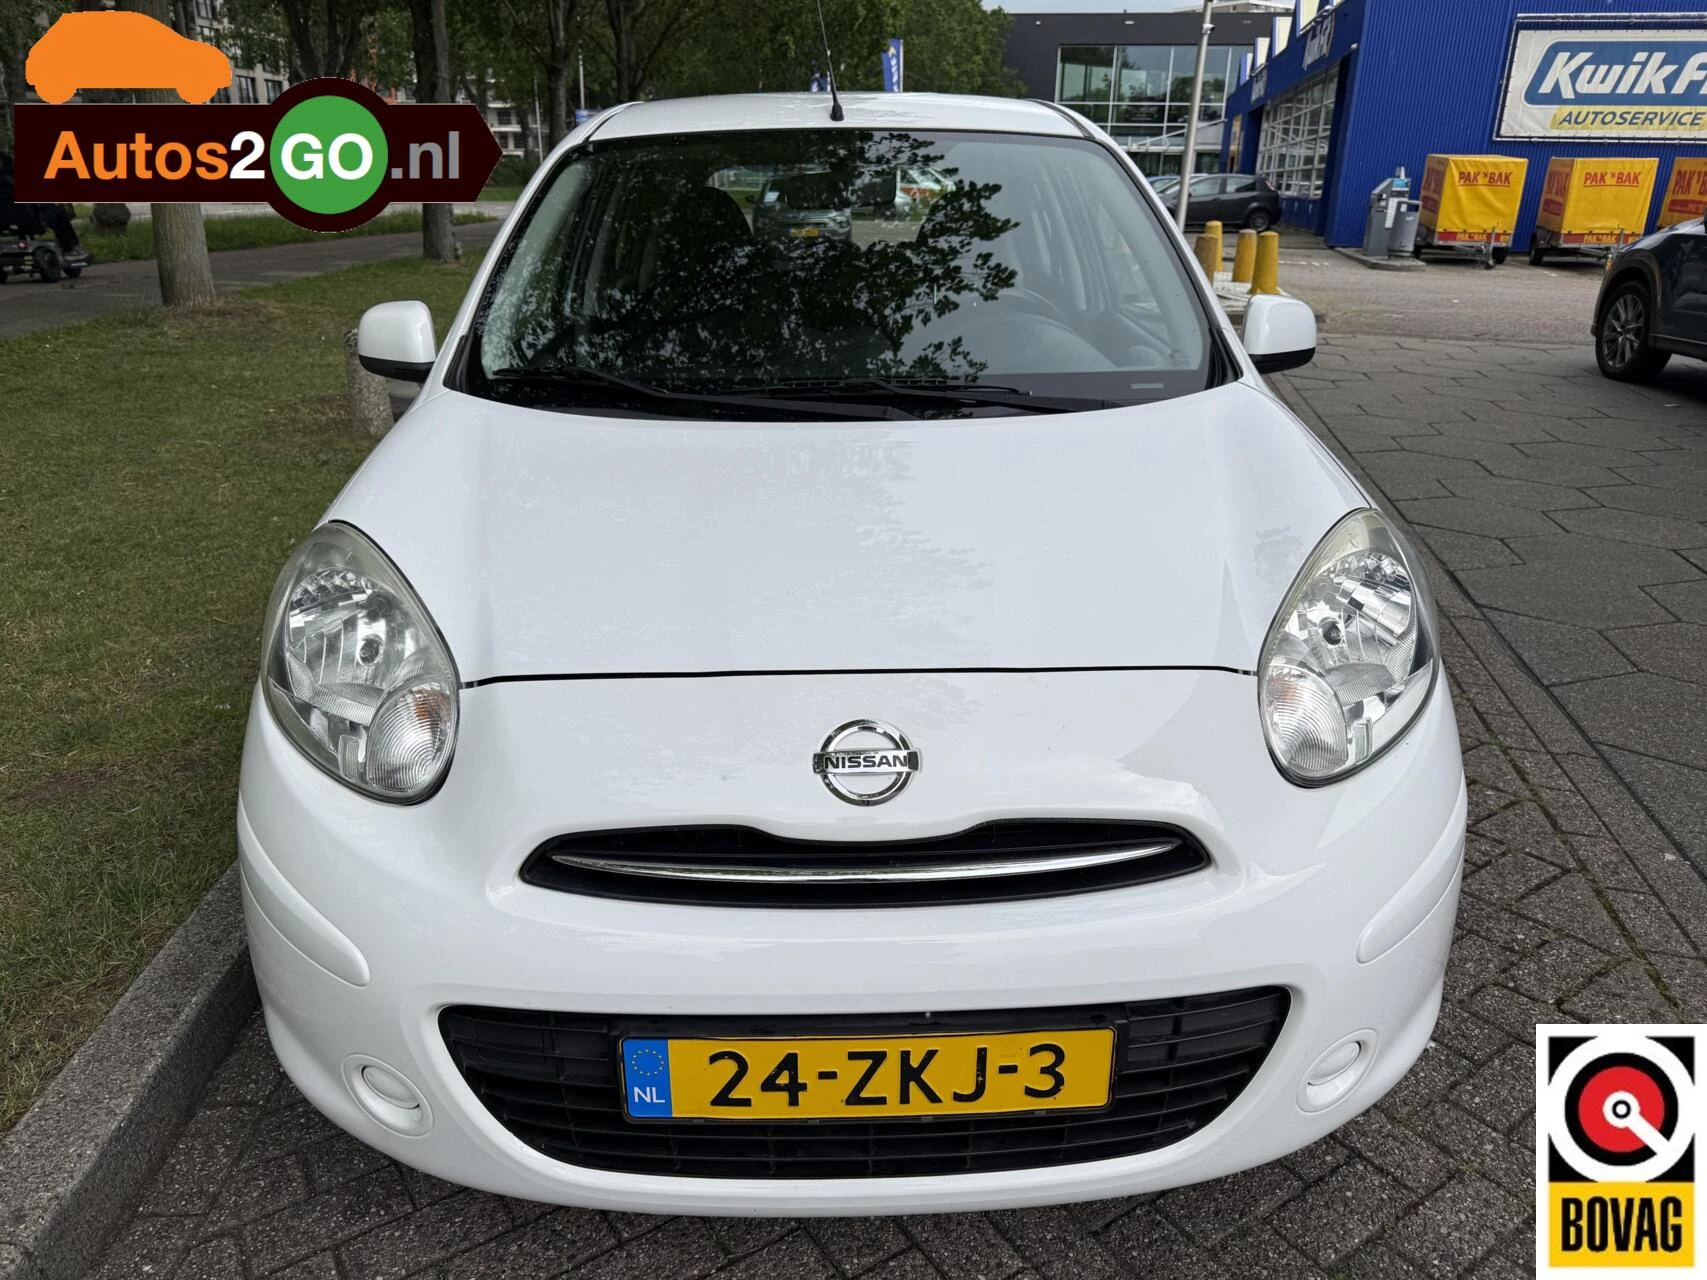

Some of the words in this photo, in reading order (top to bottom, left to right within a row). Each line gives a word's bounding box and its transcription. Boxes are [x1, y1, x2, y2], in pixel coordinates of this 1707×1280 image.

[1538, 51, 1707, 99] KwikF
[1559, 111, 1706, 126] AUTOSERVICE
[1458, 171, 1481, 184] PAK
[1488, 171, 1512, 185] BAK
[1584, 171, 1608, 185] PAK
[1616, 171, 1641, 185] BAK
[824, 755, 908, 769] NISSAN
[633, 1087, 665, 1103] NL
[708, 1043, 1066, 1107] 24-ZKJ-3
